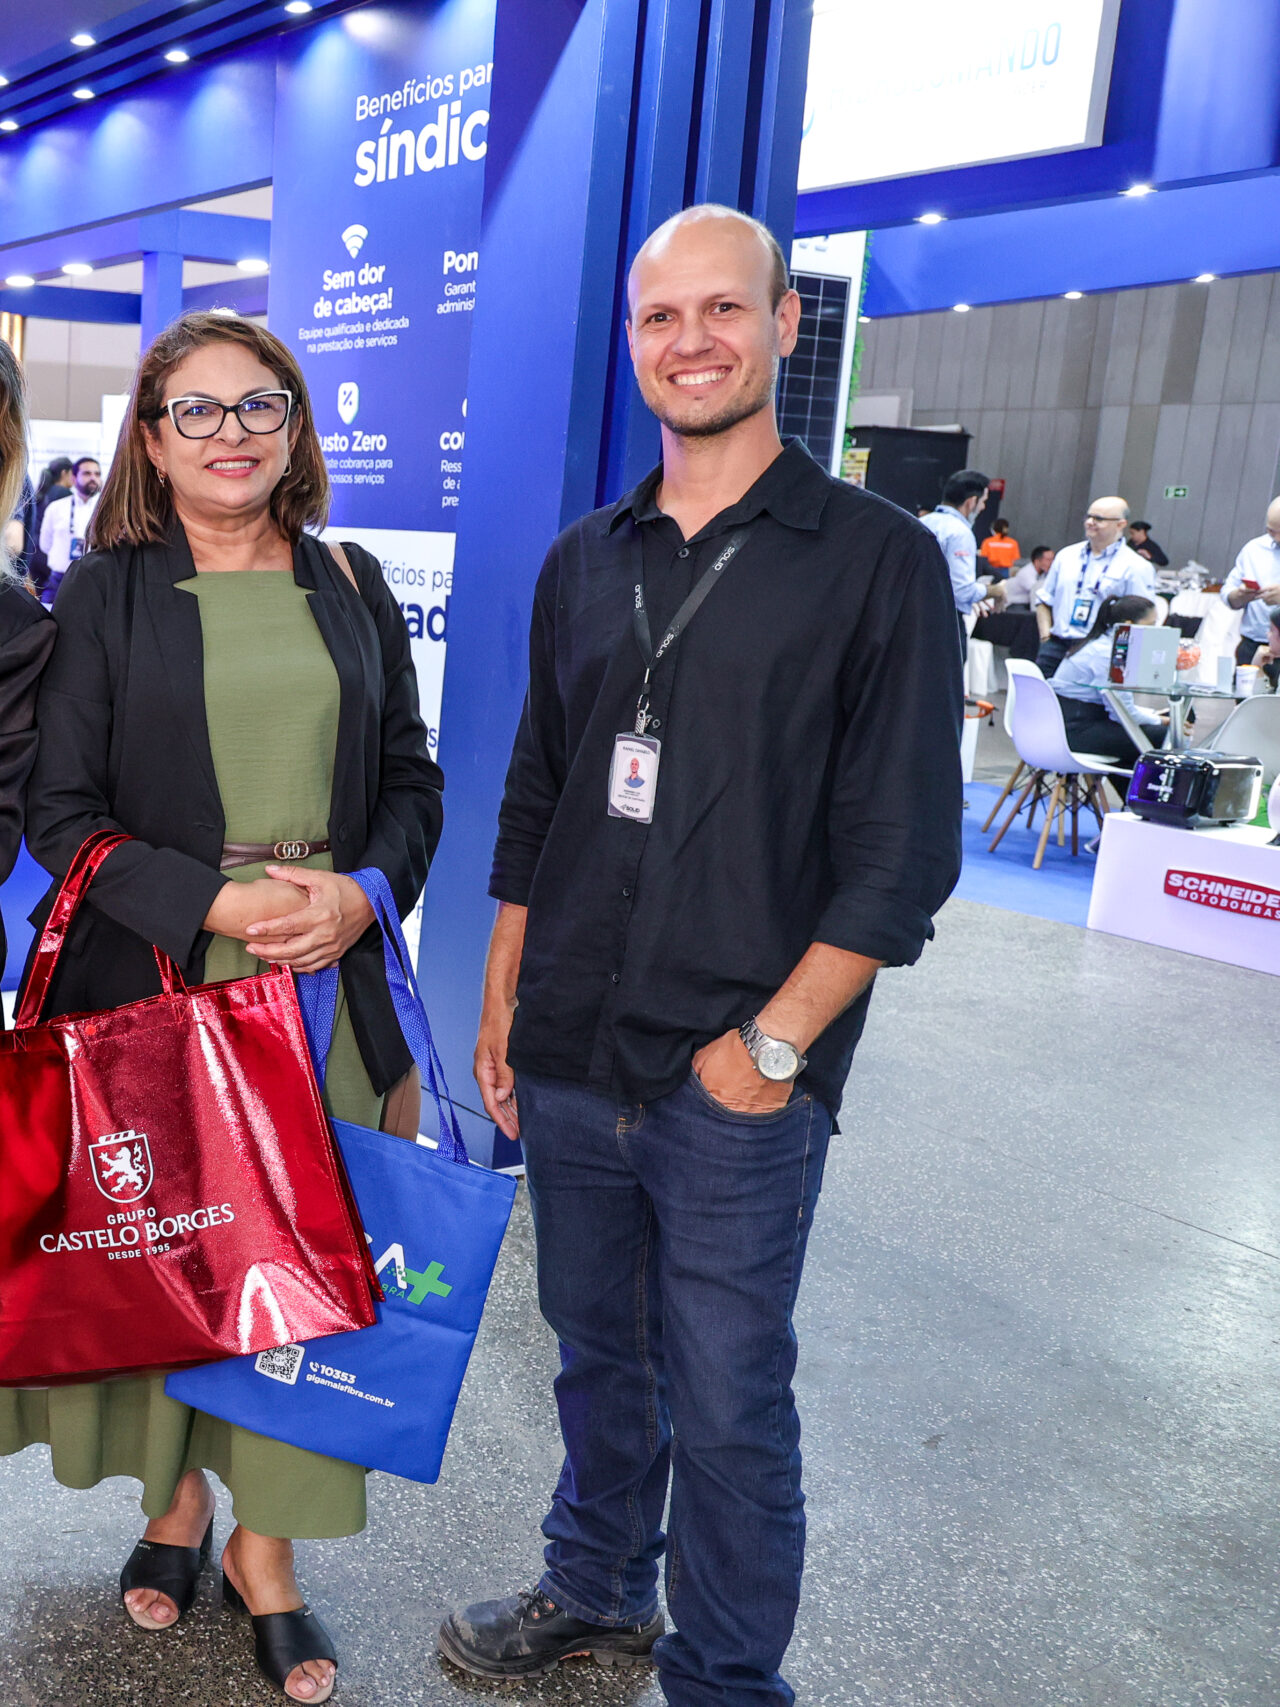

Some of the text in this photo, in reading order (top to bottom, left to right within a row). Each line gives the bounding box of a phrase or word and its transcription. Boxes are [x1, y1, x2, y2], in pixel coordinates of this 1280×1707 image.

[355, 63, 494, 121] Benefícios par
[354, 100, 490, 187] síndic
[443, 250, 478, 275] Pon
[323, 263, 385, 291] Sem dor
[314, 288, 393, 319] de cabeça!
[298, 316, 409, 340] Equipe qualificada e dedicada
[307, 334, 398, 354] na prestação de serviços
[317, 431, 387, 452] usto Zero
[339, 457, 374, 470] cobrança
[375, 459, 393, 471] para
[329, 472, 385, 485] nossos serviços
[442, 476, 456, 490] de
[442, 496, 459, 508] pre
[714, 546, 735, 571] SOLID
[399, 594, 451, 642] ad
[655, 632, 675, 658] SOLID
[107, 1206, 157, 1225] GRUPO
[39, 1203, 235, 1253] CASTELO BORGES
[107, 1243, 171, 1260] DESDE 1995
[320, 1364, 357, 1384] 10353
[306, 1373, 395, 1408] gigamaisfibra.com.br
